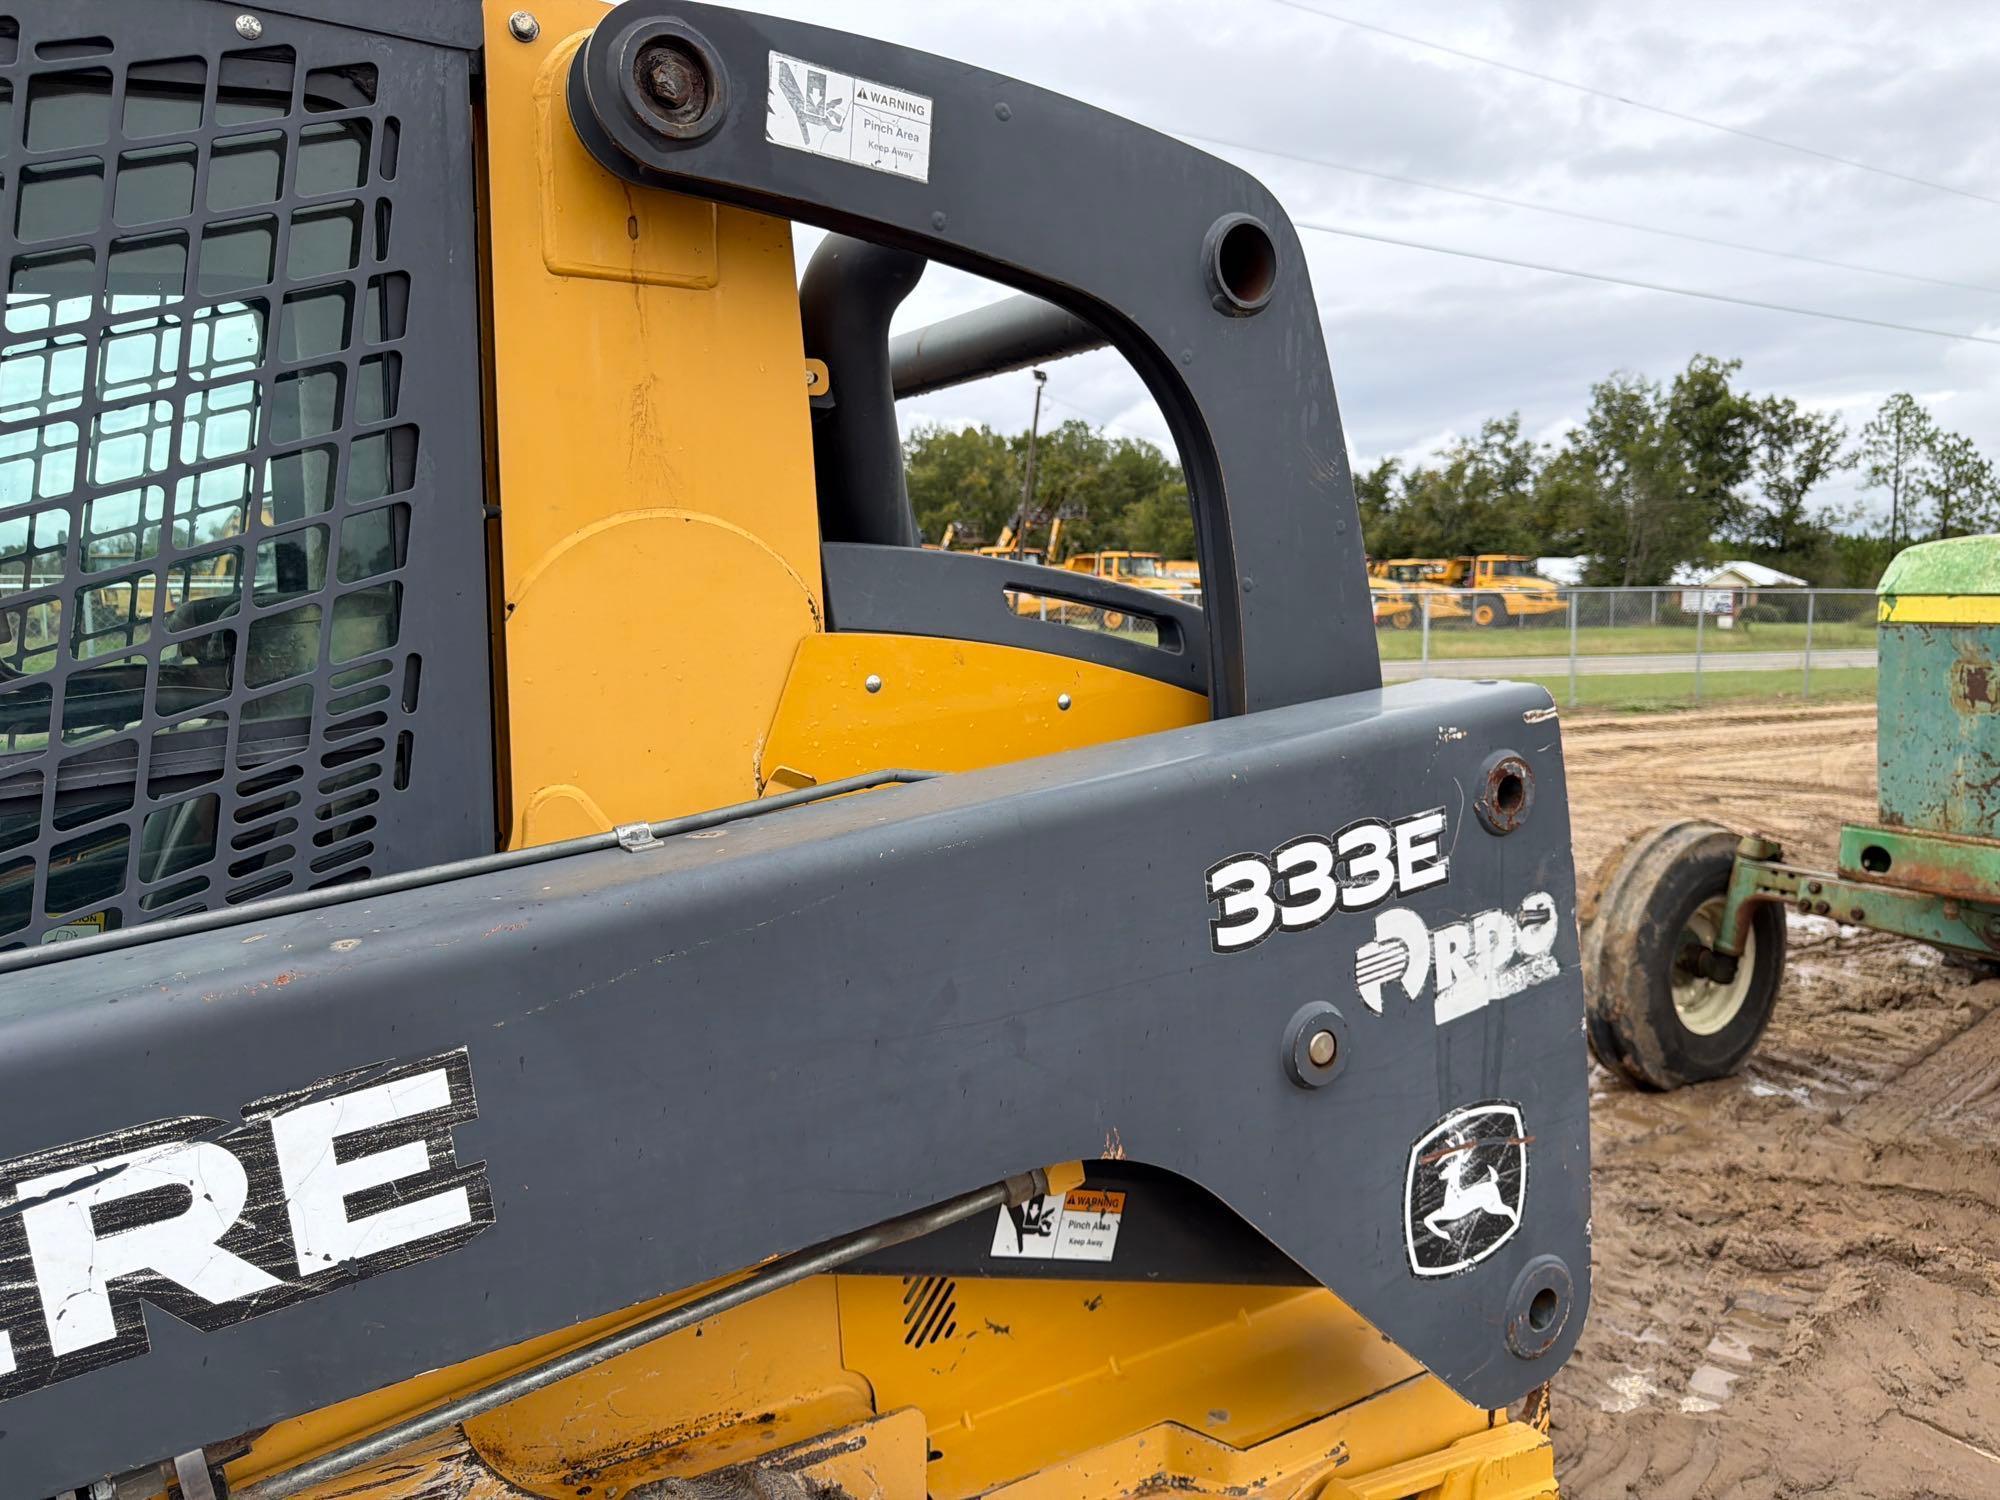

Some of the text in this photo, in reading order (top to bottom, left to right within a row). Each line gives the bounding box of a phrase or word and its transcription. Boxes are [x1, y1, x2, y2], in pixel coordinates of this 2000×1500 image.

[871, 92, 924, 115] WARNING
[864, 119, 919, 142] Pinch Area
[868, 141, 913, 160] Keep Away
[1210, 812, 1447, 948] 333E
[1078, 1197, 1119, 1208] WARNING
[0, 1067, 472, 1376] RE
[1068, 1220, 1090, 1230] Pinch
[1069, 1238, 1103, 1248] Keep Away
